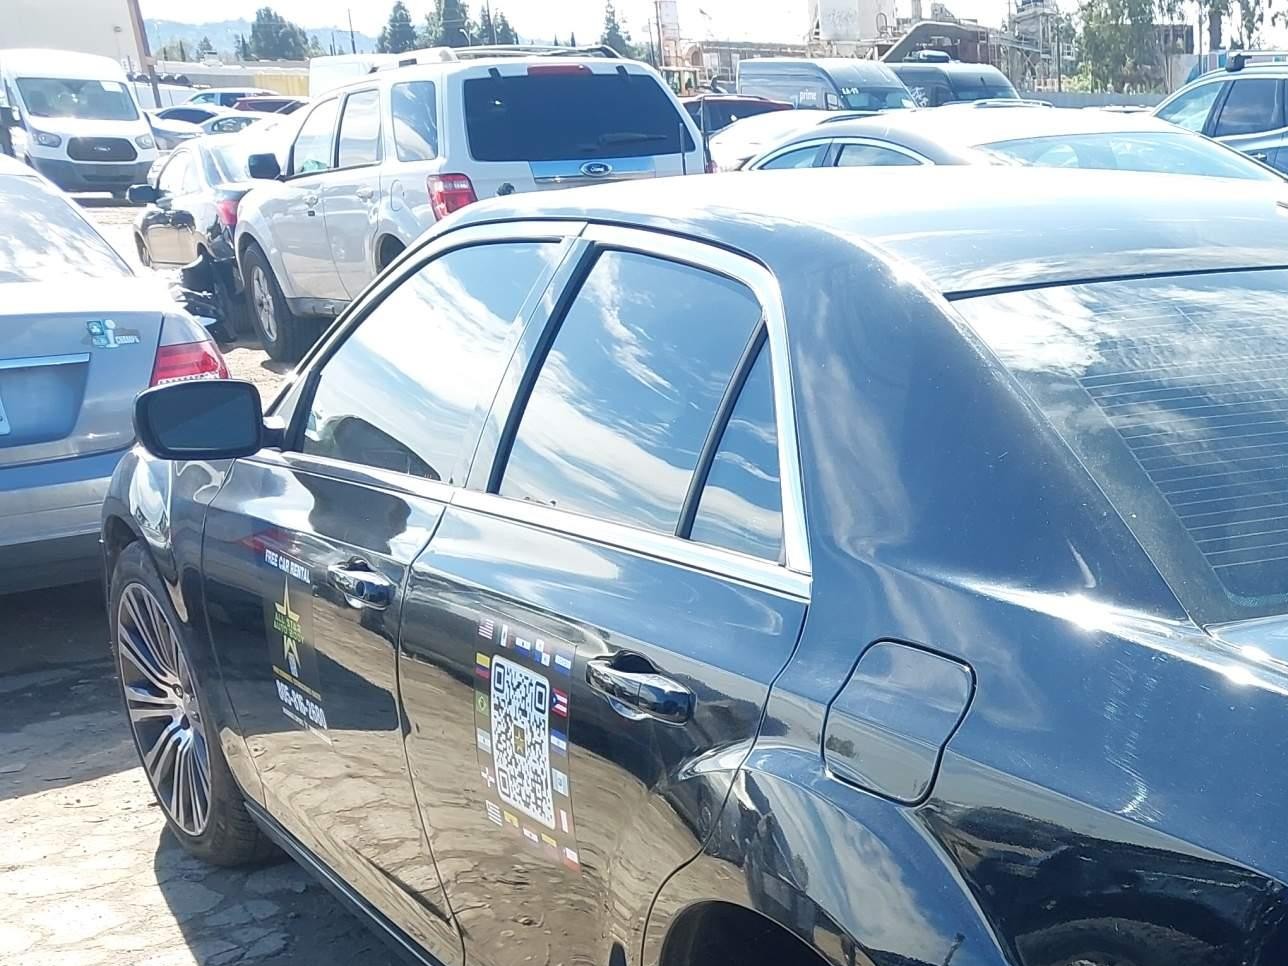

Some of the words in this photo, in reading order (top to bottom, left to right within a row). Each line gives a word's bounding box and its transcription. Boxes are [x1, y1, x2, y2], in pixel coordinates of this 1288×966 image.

[265, 549, 279, 568] FREE
[278, 555, 290, 573] CAR
[289, 561, 311, 584] RENTAL
[273, 620, 288, 636] AUTO
[275, 612, 286, 624] ALL
[286, 618, 302, 633] STAR
